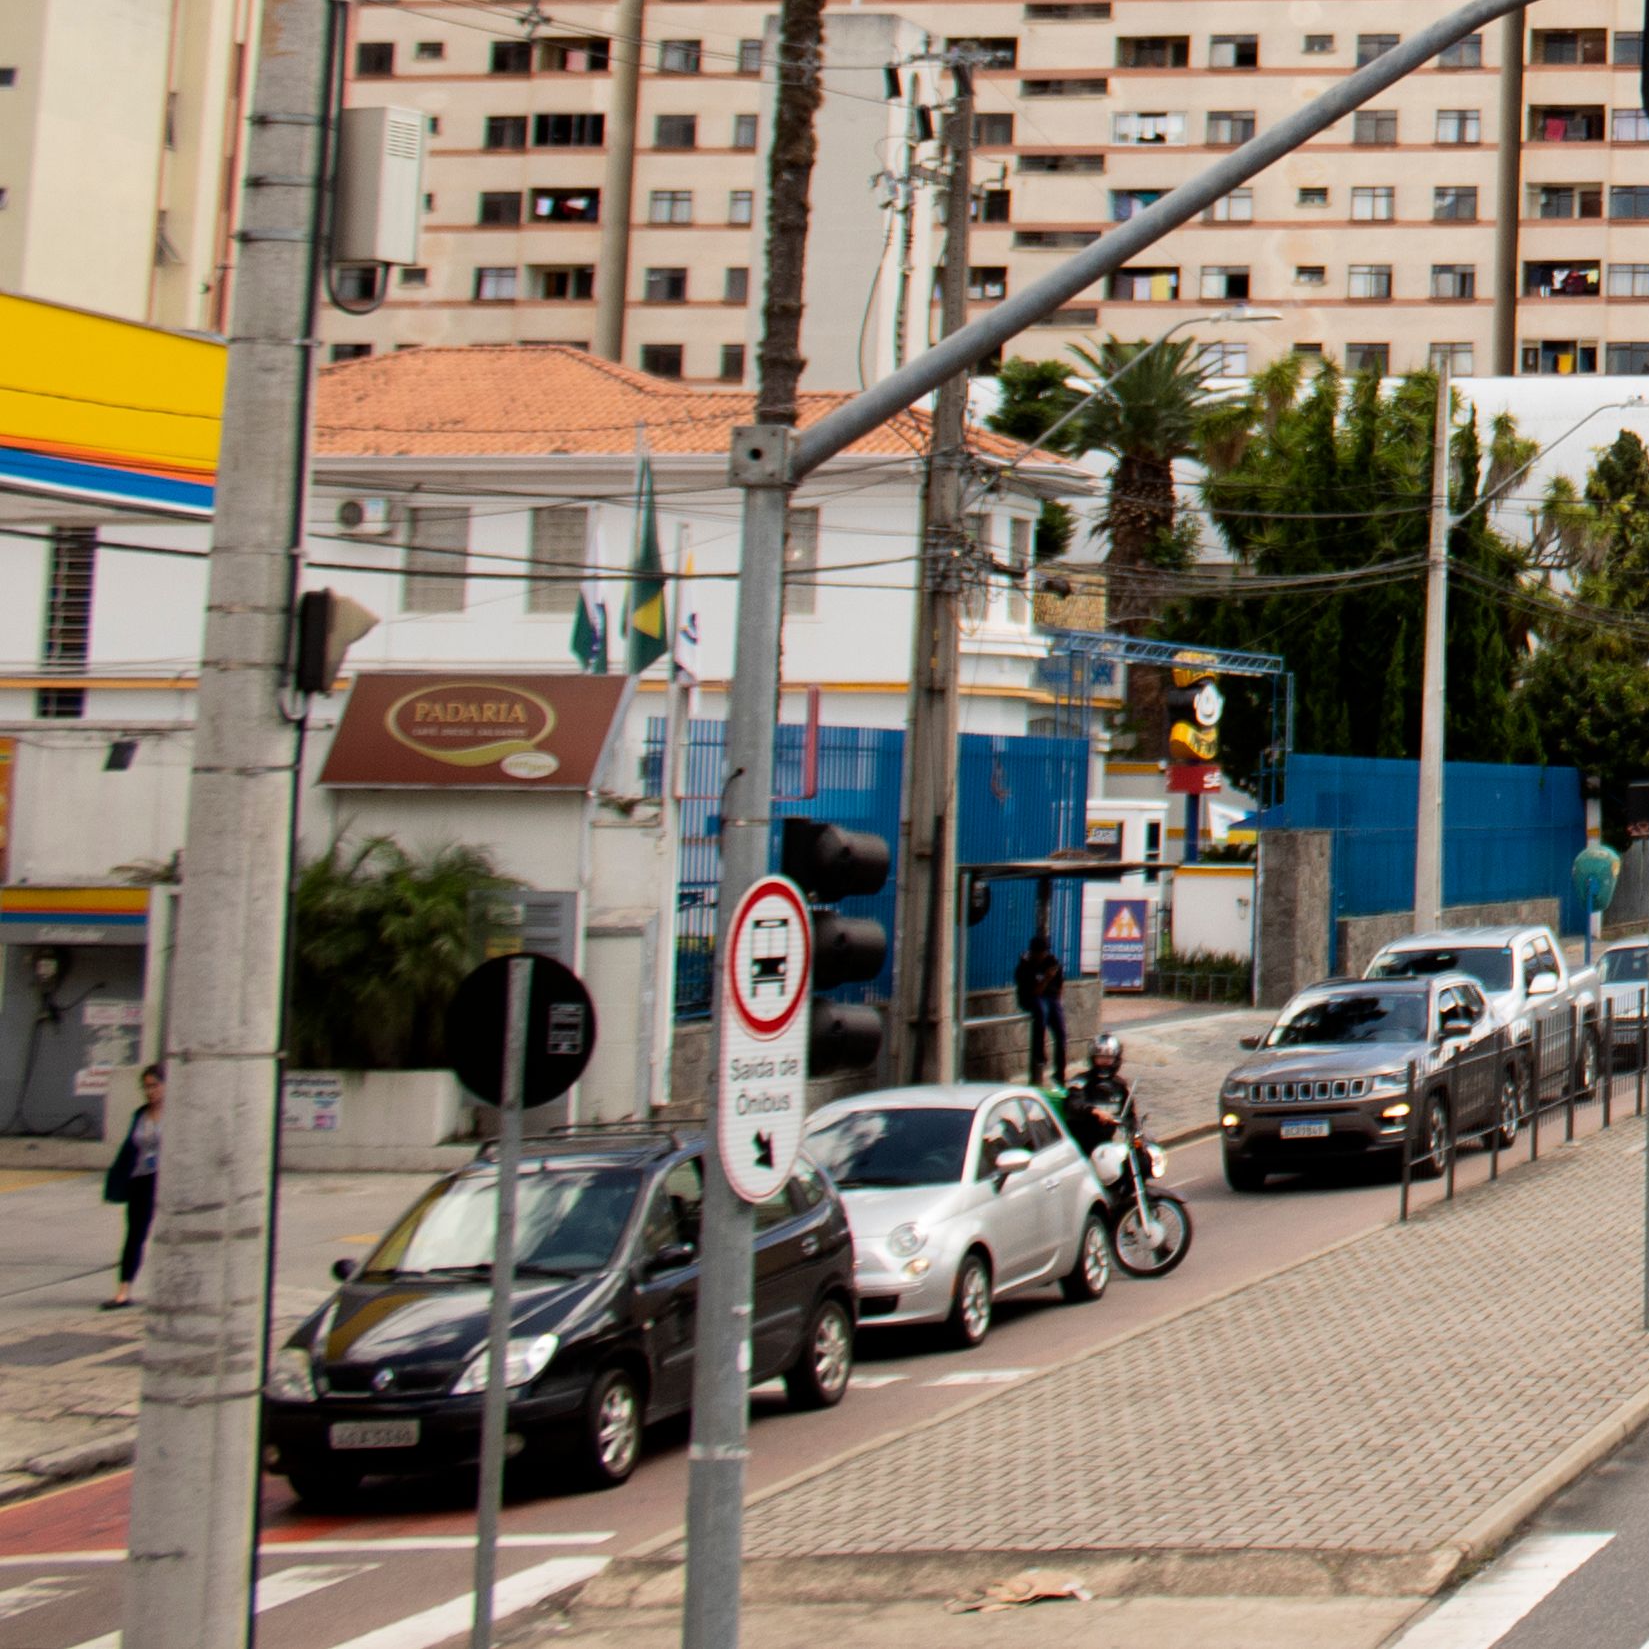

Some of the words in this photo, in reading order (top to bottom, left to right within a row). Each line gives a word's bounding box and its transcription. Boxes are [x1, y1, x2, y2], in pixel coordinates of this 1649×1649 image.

[414, 702, 527, 723] PADARIA
[731, 1057, 774, 1081] Saída
[779, 1056, 799, 1076] de
[736, 1087, 791, 1116] Ônibus
